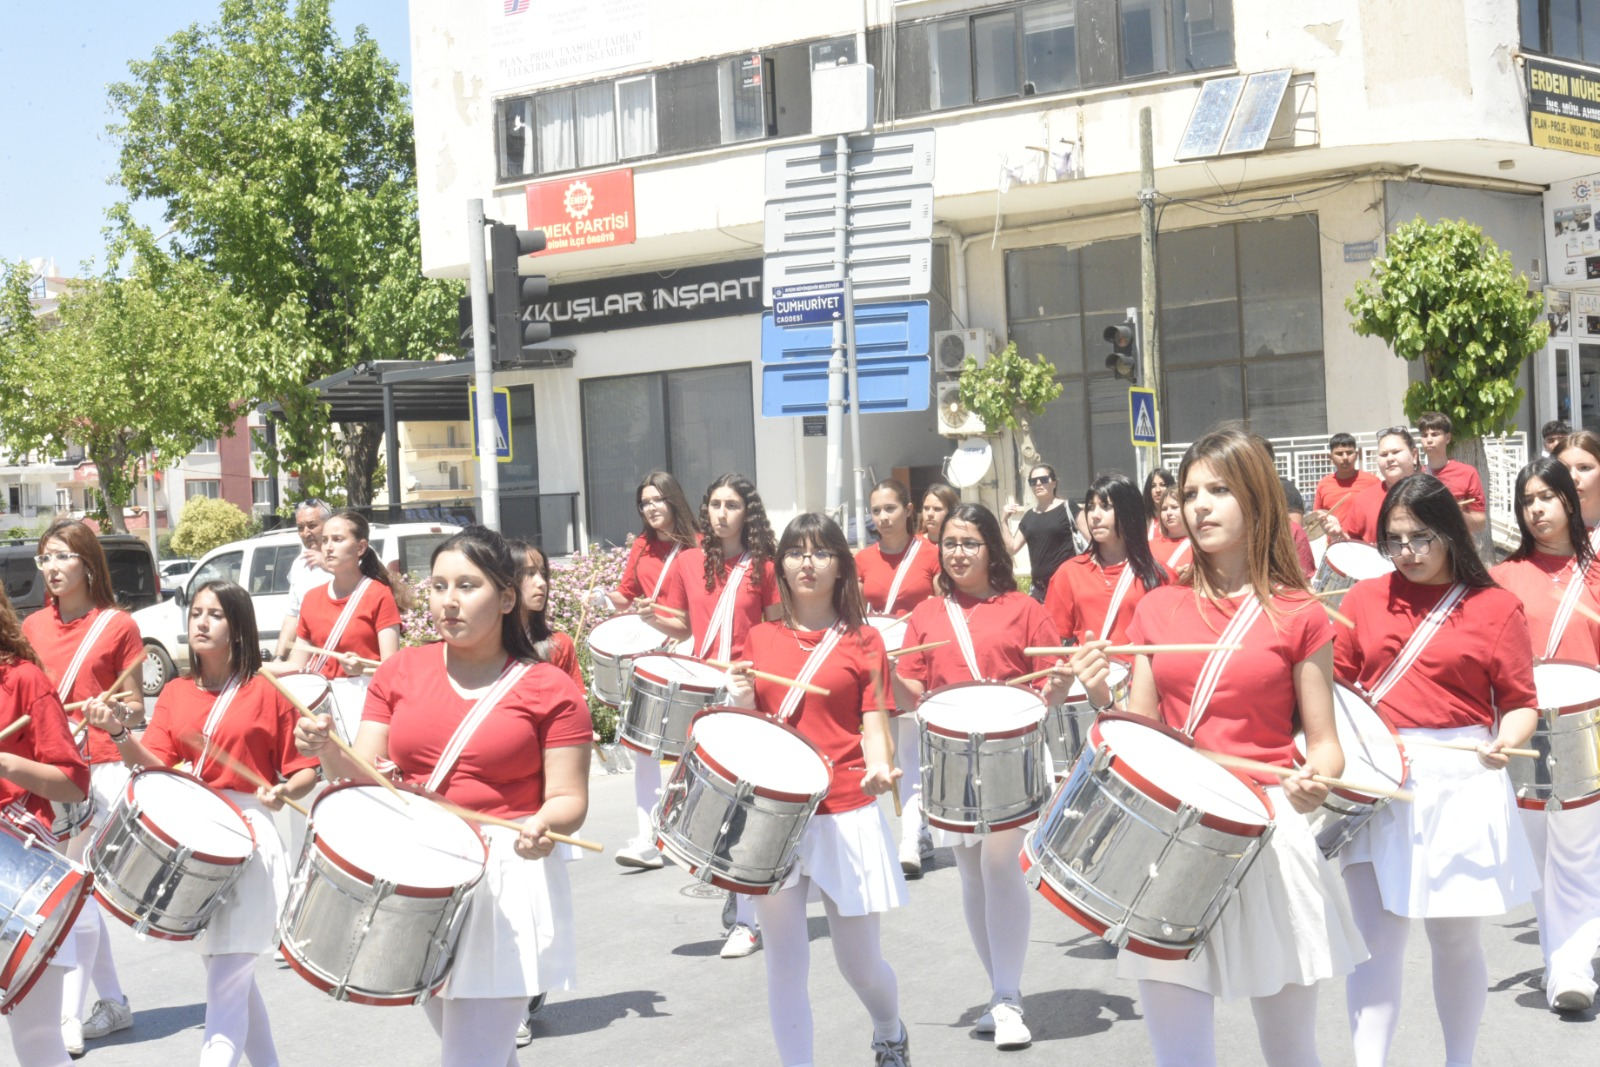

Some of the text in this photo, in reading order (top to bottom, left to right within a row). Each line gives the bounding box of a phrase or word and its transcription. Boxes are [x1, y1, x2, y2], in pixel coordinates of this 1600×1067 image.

[499, 57, 522, 69] PLAN
[530, 47, 556, 63] PROJE
[553, 54, 583, 69] ABONE
[1531, 69, 1600, 103] ERDEM MÜHE
[1545, 97, 1561, 116] İNŞ.
[1561, 101, 1581, 117] MÜH.
[1534, 118, 1547, 130] PLAN
[1551, 120, 1566, 133] PROJE
[1548, 135, 1562, 145] 0530
[1574, 139, 1582, 148] 44
[571, 195, 588, 205] EMEP
[533, 211, 628, 238] MEK PARTİSİ
[547, 232, 615, 249] DİDİM İLÇE ÖRGÜTÜ
[653, 276, 761, 309] İNŞAAT
[776, 296, 840, 314] CUMHURİYET
[776, 314, 803, 323] CADDESİ
